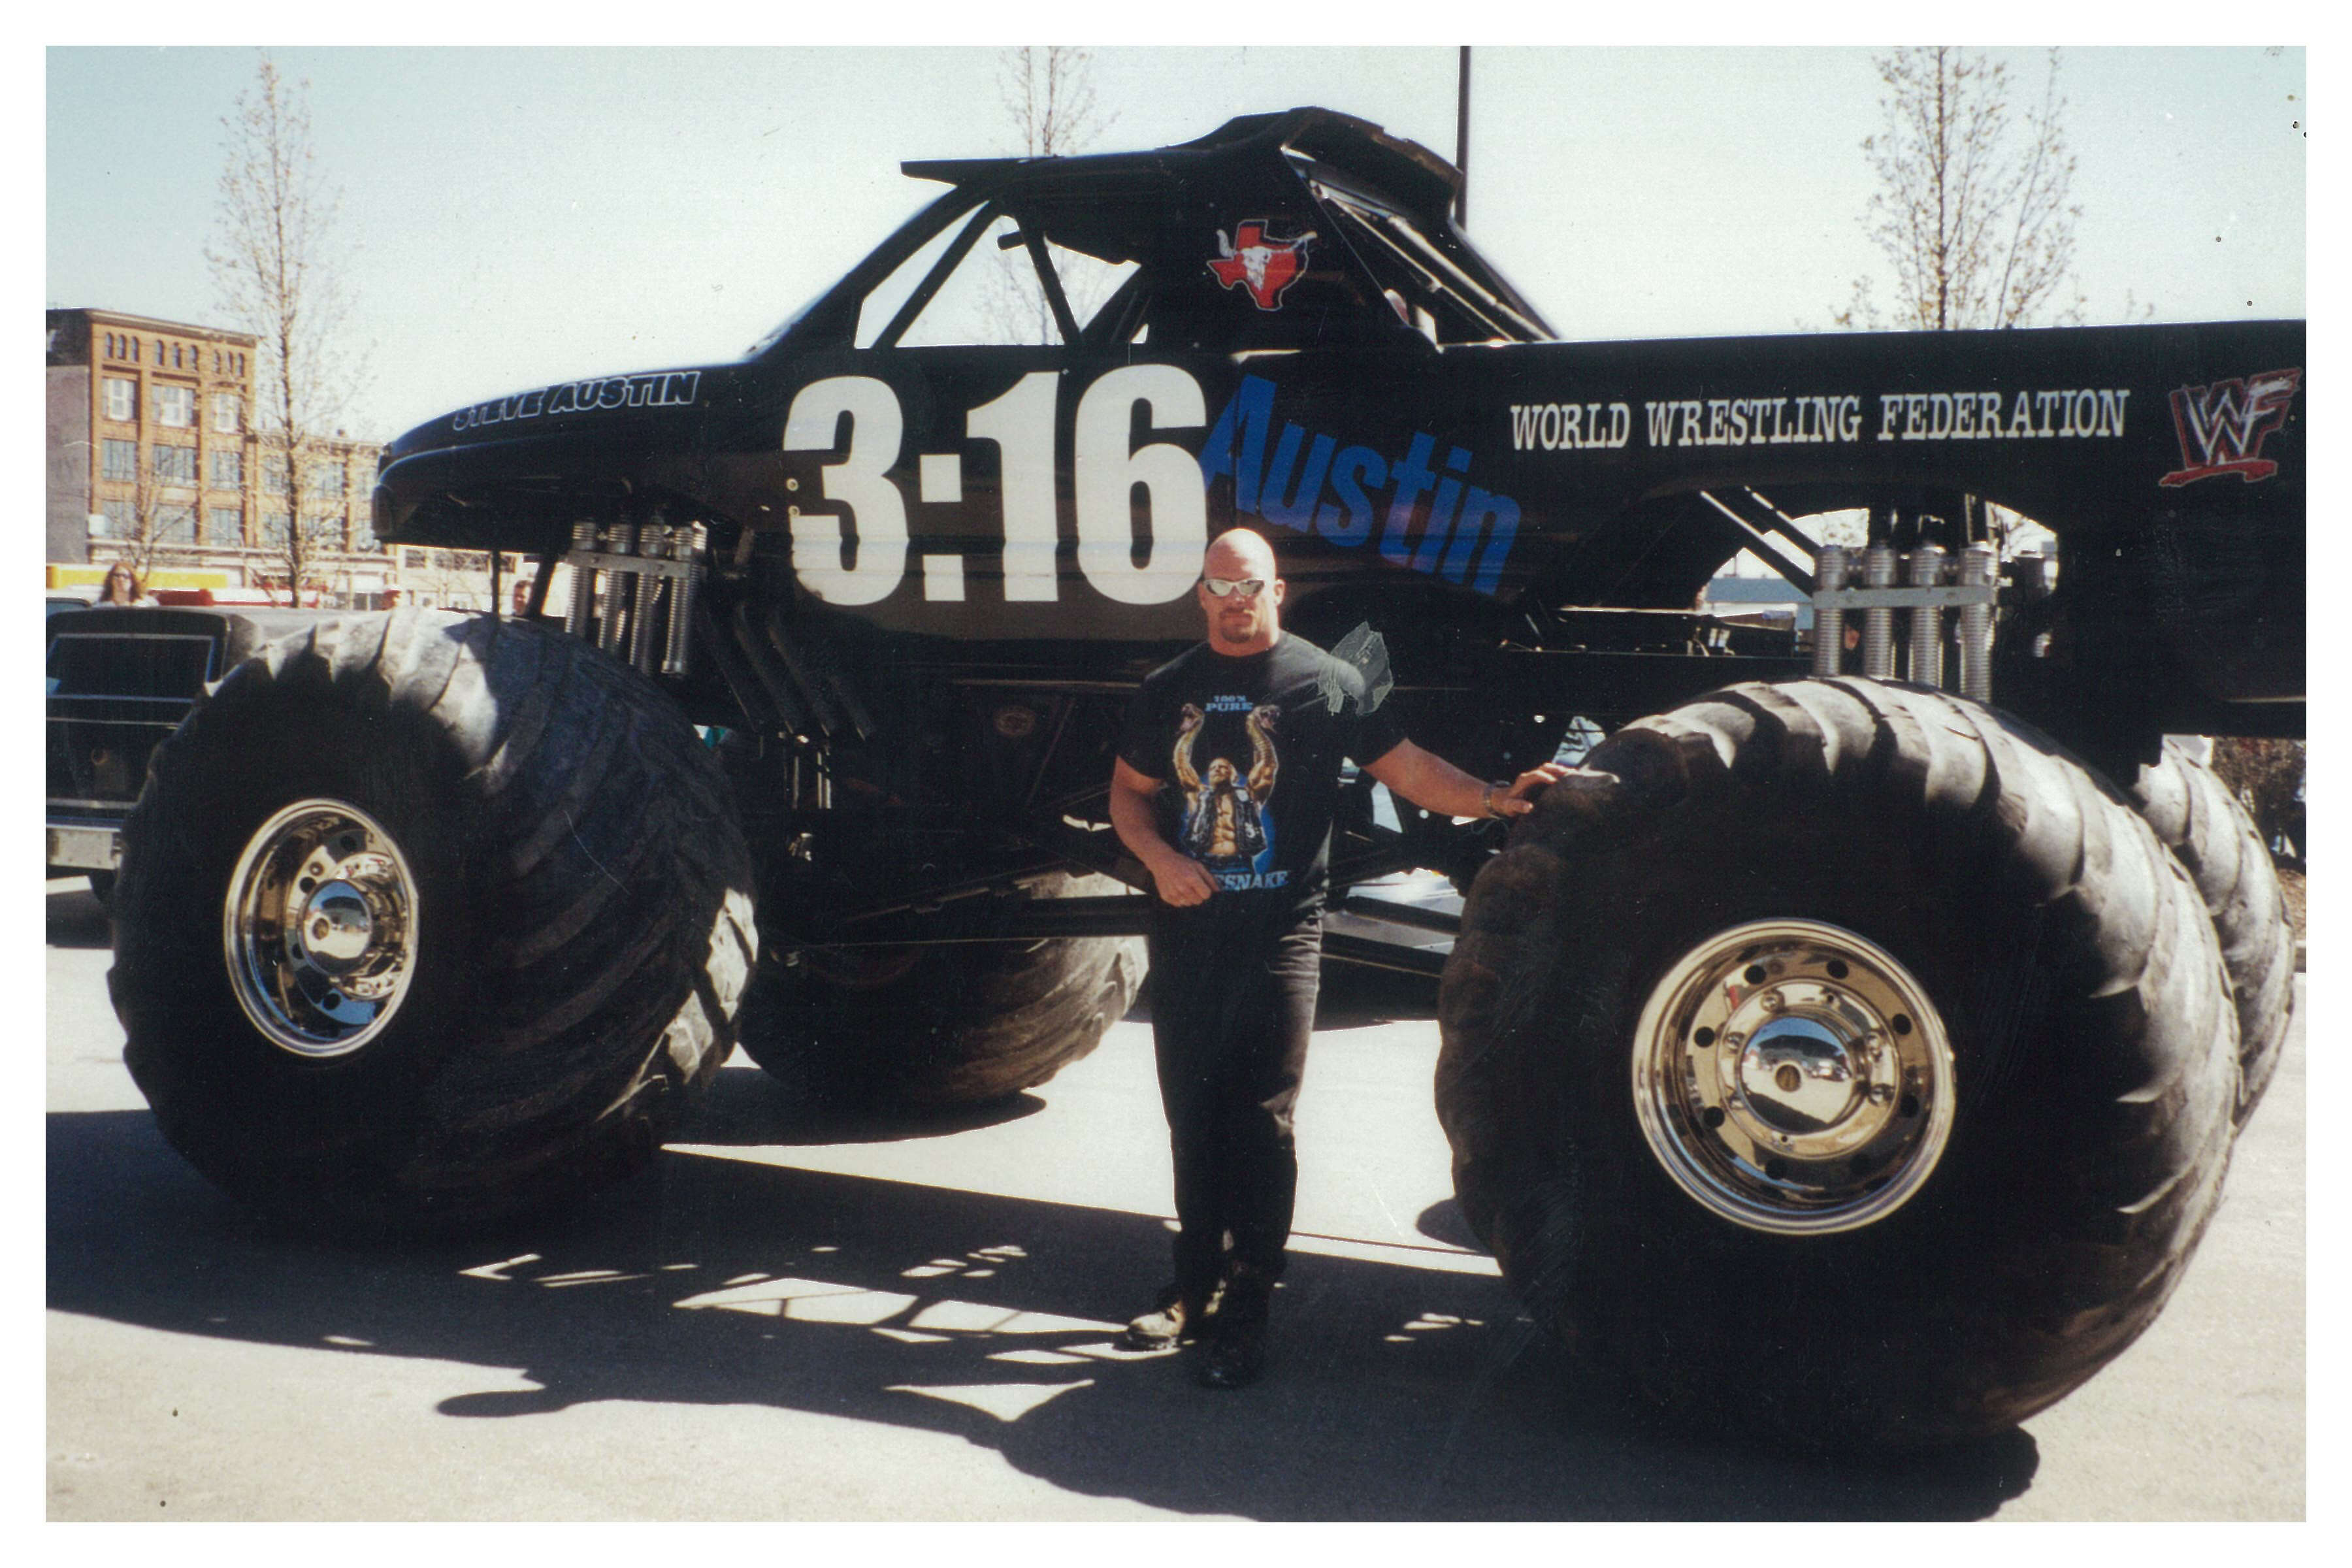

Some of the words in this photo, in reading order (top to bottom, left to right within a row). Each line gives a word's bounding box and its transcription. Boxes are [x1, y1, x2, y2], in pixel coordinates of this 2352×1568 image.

[453, 387, 547, 431] STEVE
[549, 371, 700, 414] AUSTIN
[1511, 402, 1630, 451] WORLD
[1645, 395, 1862, 447] WRESTLING
[1877, 389, 2131, 441] FEDERATION
[783, 364, 1207, 605] 3:16
[1200, 374, 1521, 595] Austin
[1205, 702, 1254, 711] PURE
